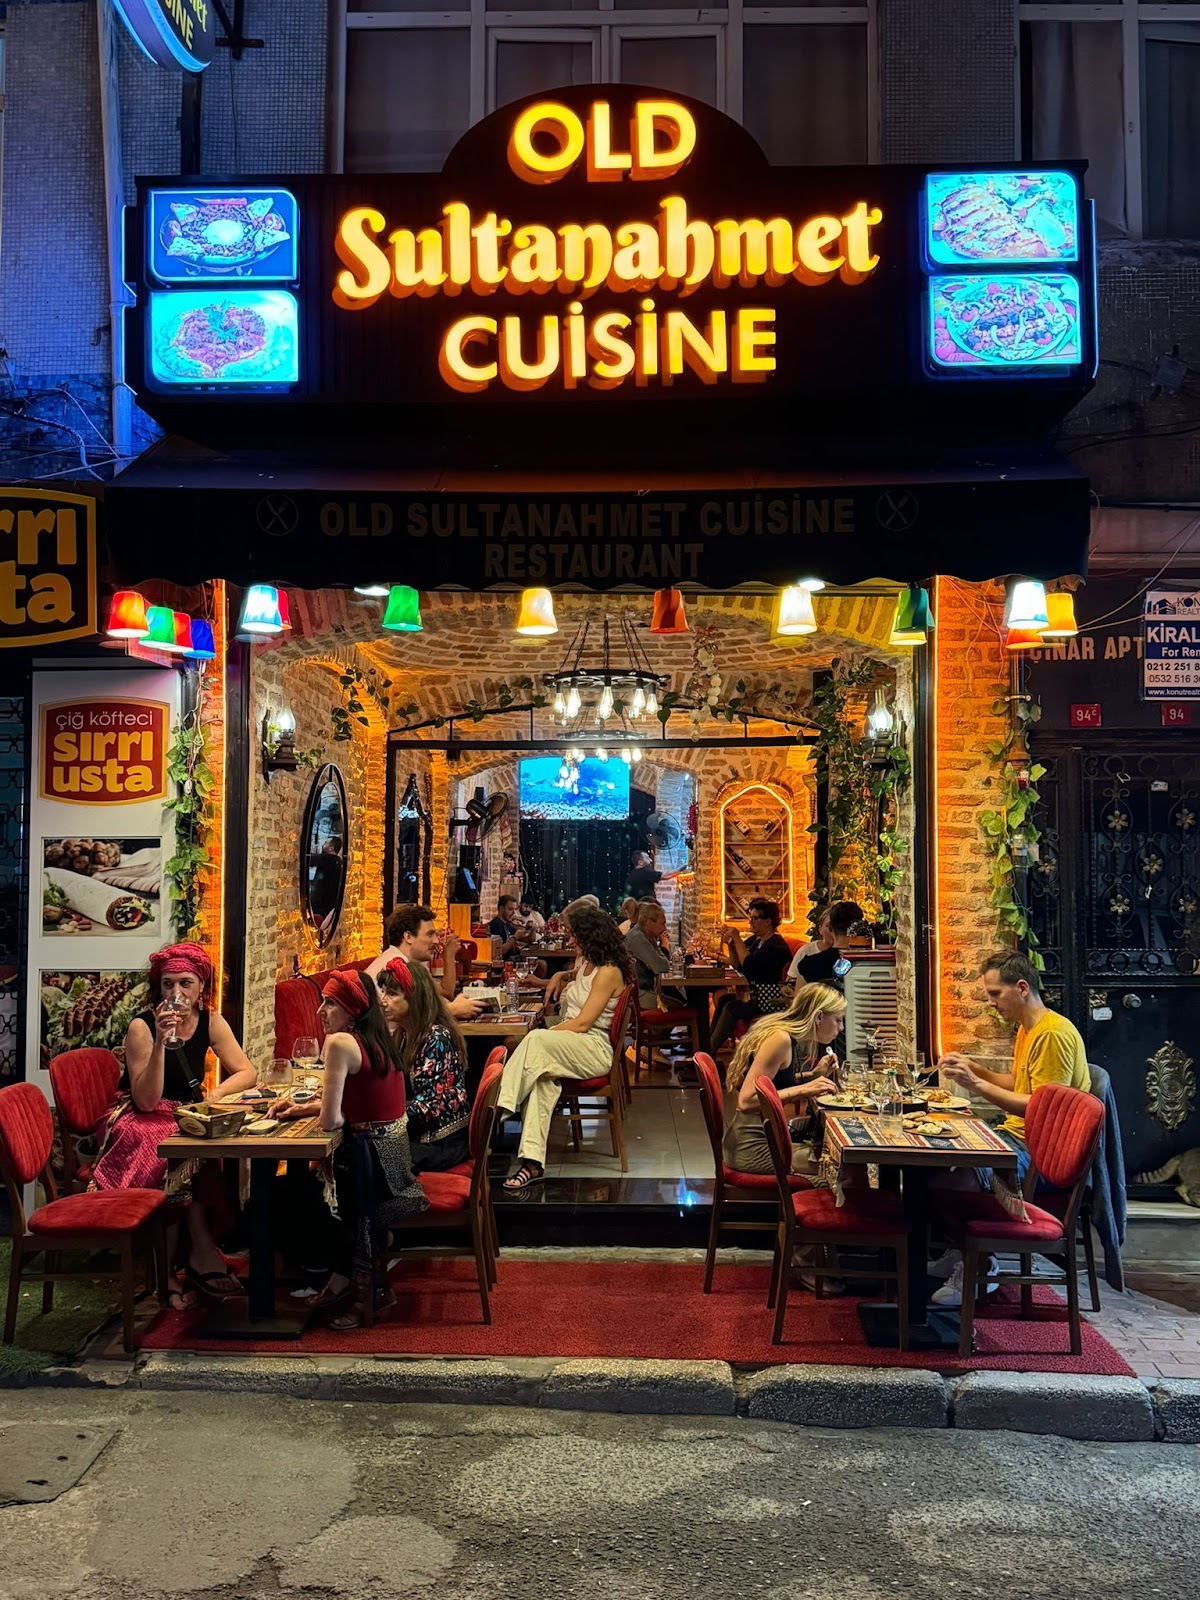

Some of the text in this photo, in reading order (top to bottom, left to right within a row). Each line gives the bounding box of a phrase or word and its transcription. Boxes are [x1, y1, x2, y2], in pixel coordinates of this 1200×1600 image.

[513, 101, 697, 172] OLD
[336, 195, 882, 299] Sultanahmet
[319, 503, 393, 537] OLD
[406, 502, 685, 538] SULTANAHMET
[483, 542, 705, 579] RESTAURANT
[1161, 646, 1179, 657] For
[1147, 662, 1200, 671] 0212 251 8
[1149, 674, 1172, 683] 0532
[1174, 674, 1191, 683] 516
[55, 710, 153, 730] çiğ köfteci
[1169, 708, 1184, 720] 94
[52, 758, 155, 793] usta
